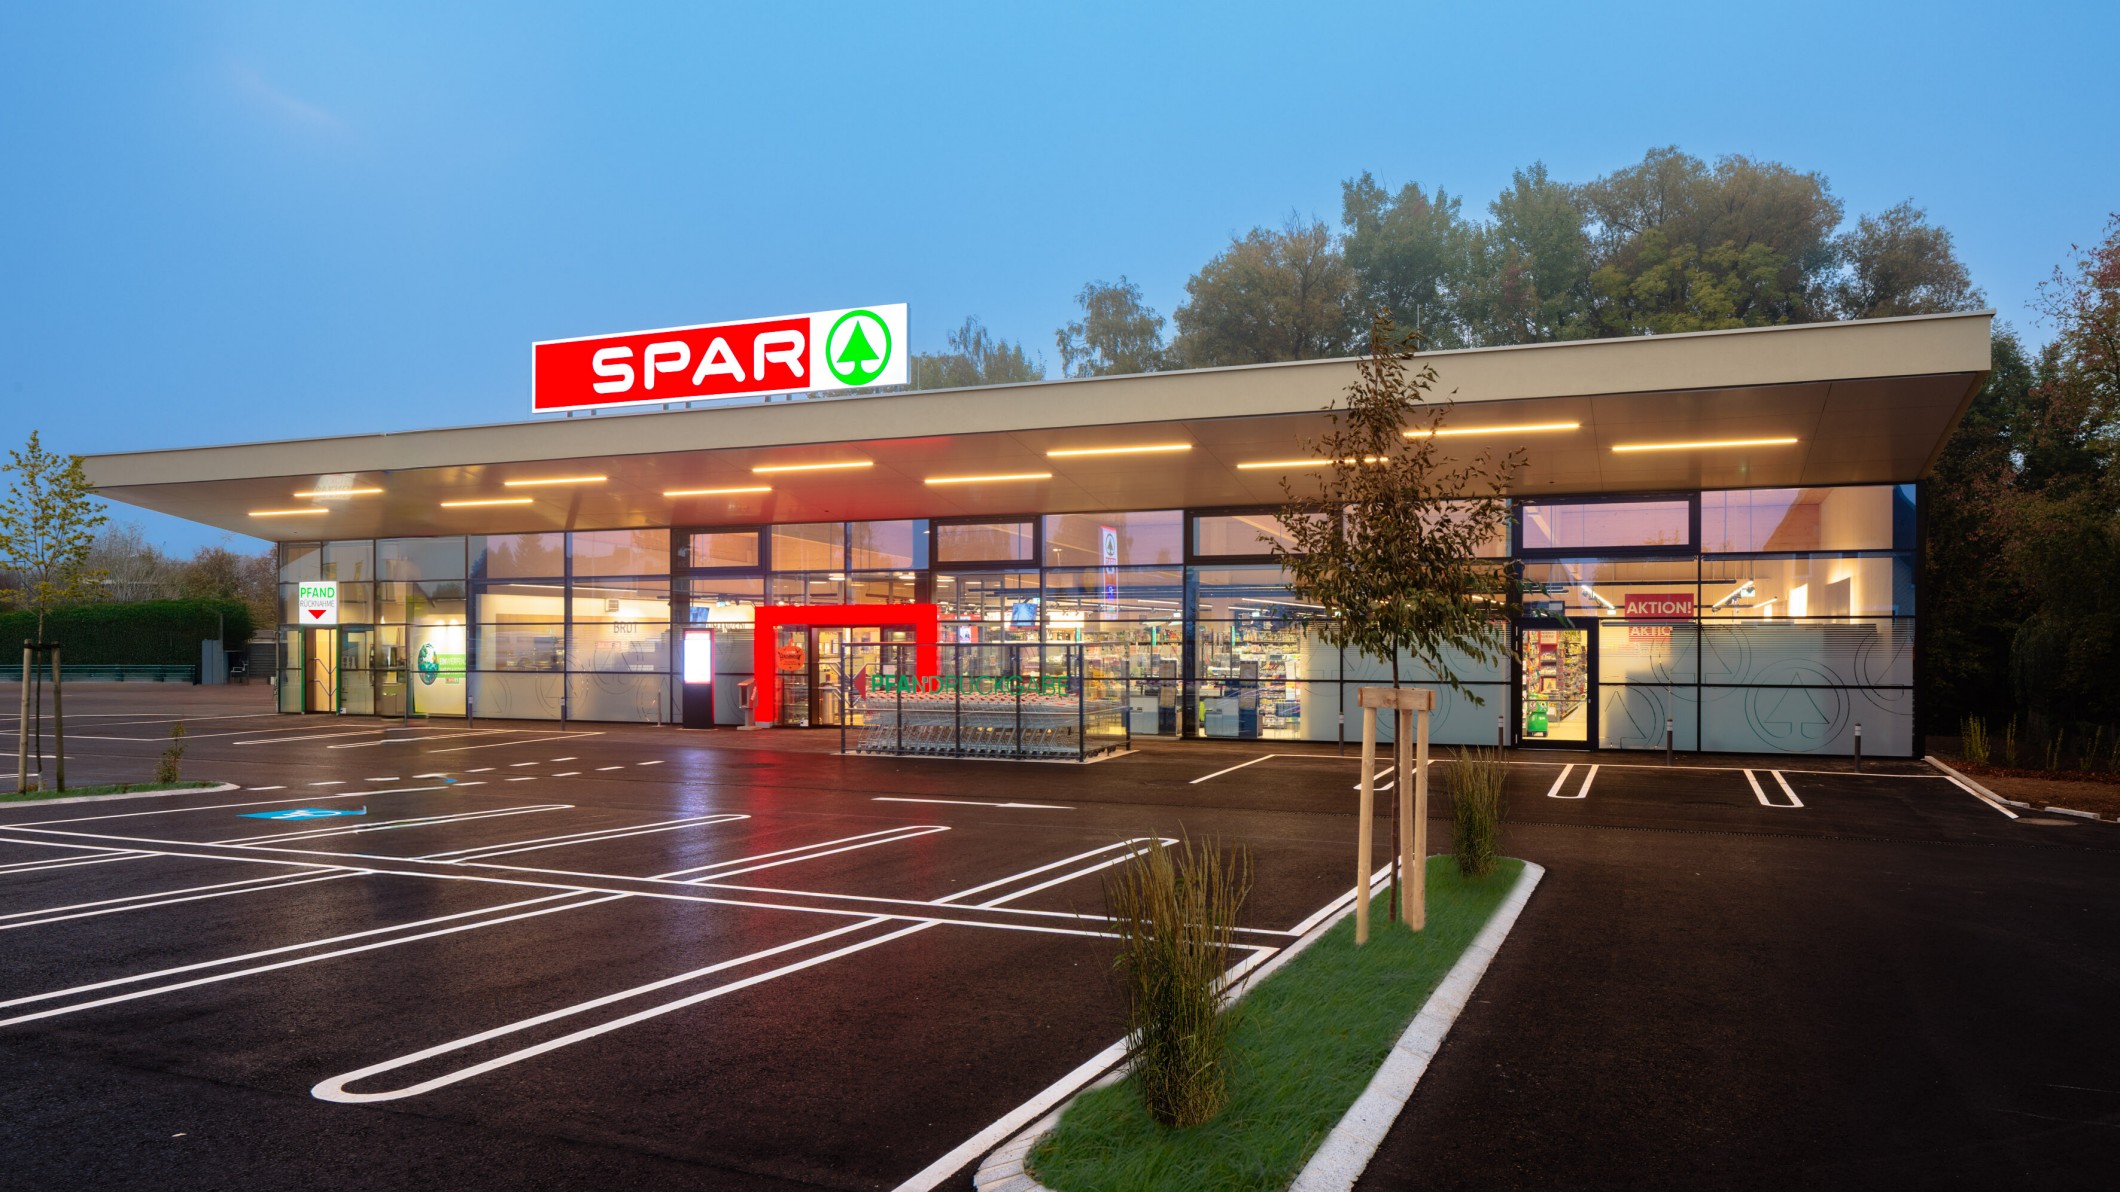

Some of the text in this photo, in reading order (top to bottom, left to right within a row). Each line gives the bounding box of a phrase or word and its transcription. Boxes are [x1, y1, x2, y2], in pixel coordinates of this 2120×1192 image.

[592, 329, 806, 395] SPAR
[300, 587, 335, 598] PFAND
[299, 599, 335, 608] RÜCKNAHME
[1626, 601, 1692, 614] AKTION!
[871, 671, 1070, 697] PFANDRÜCKGABE
